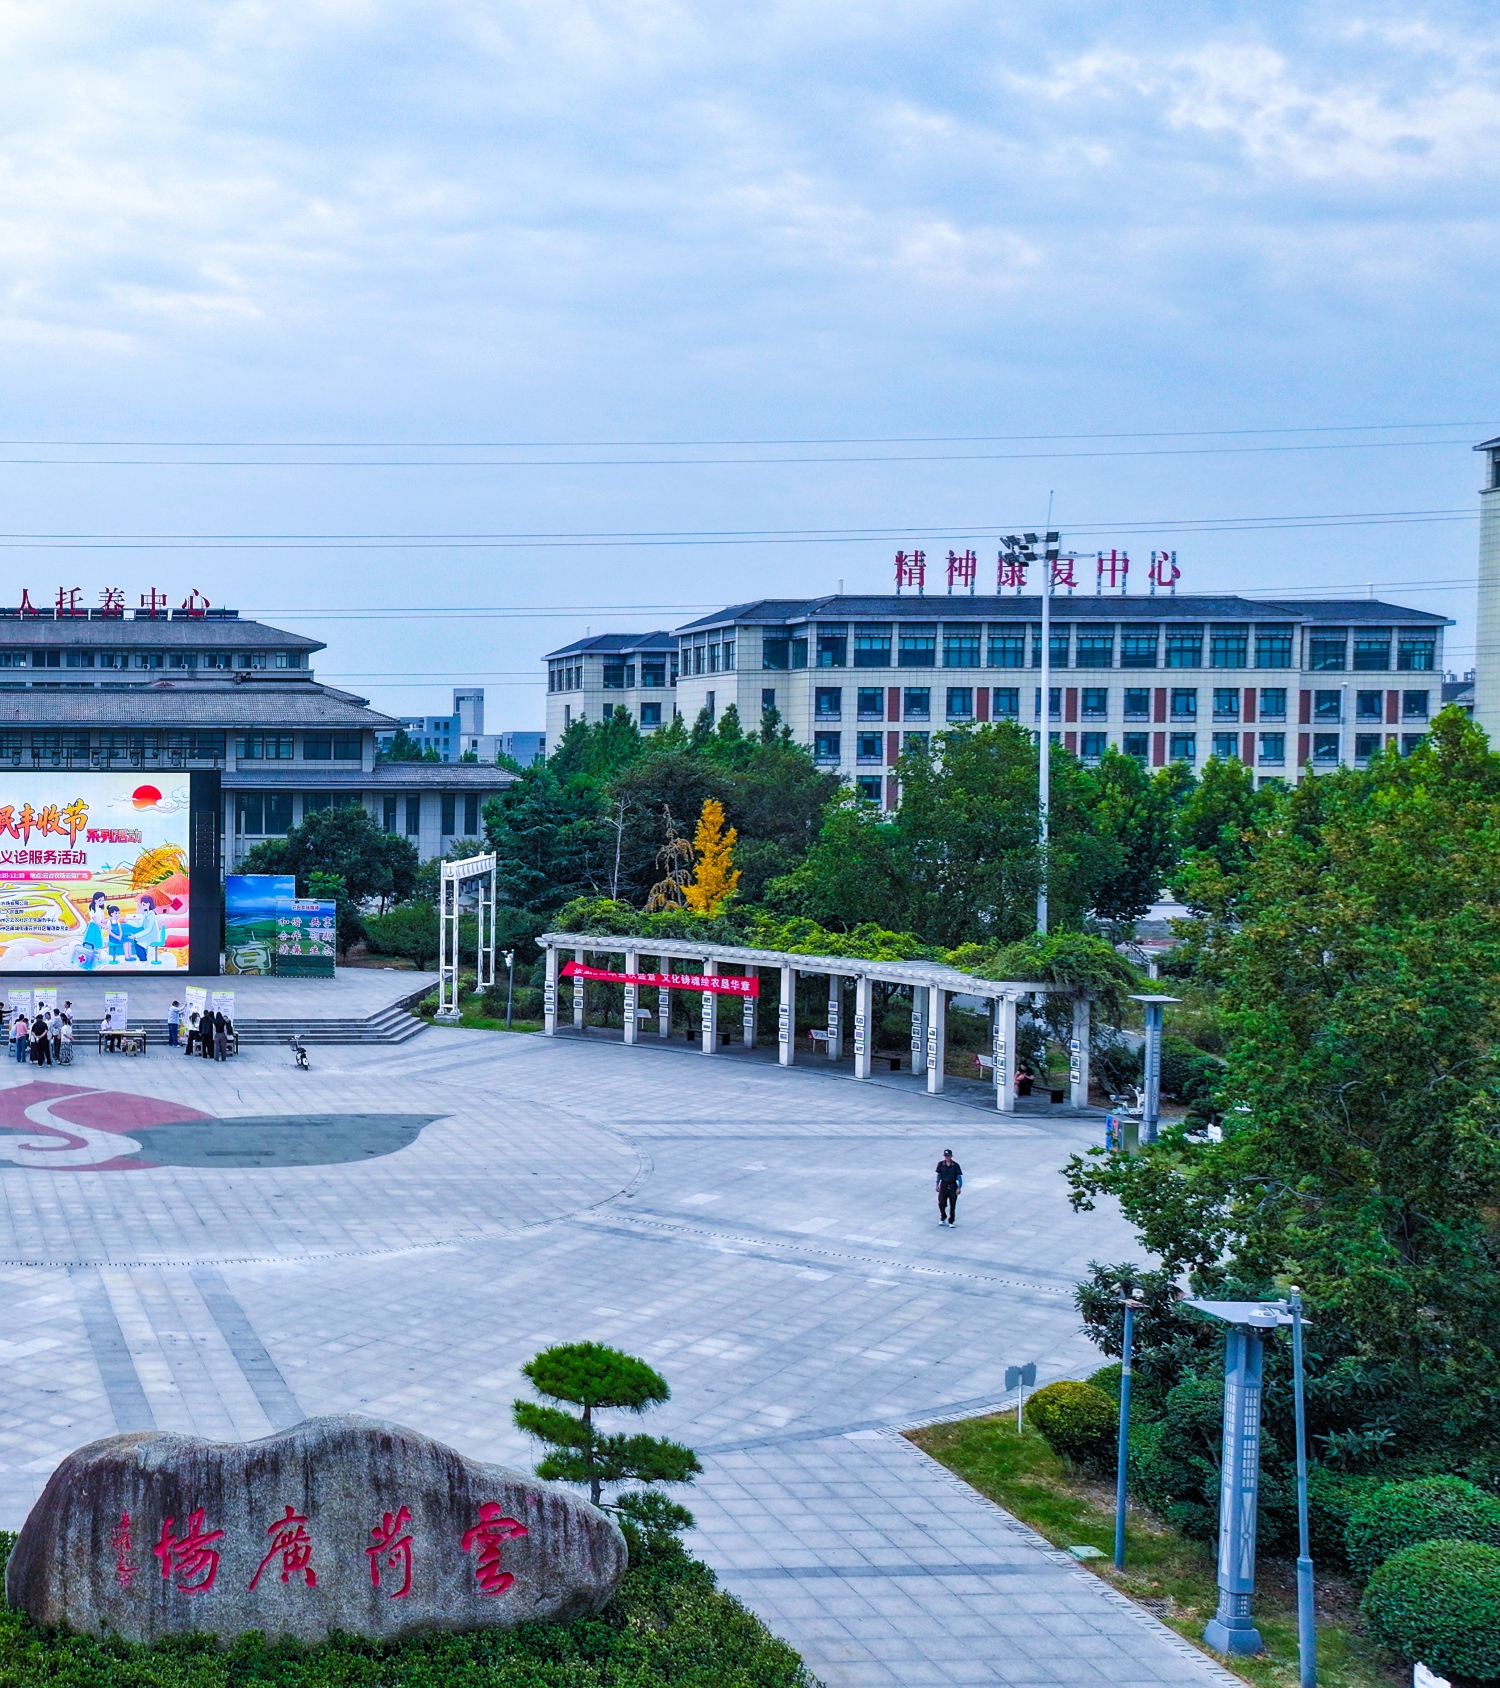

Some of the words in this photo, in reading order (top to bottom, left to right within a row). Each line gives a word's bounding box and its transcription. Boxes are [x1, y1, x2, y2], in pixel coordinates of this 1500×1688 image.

[893, 549, 1181, 588] 精神康复中心
[86, 828, 142, 844] 系列活动
[661, 973, 751, 991] 文化铸魂绘农垦华章
